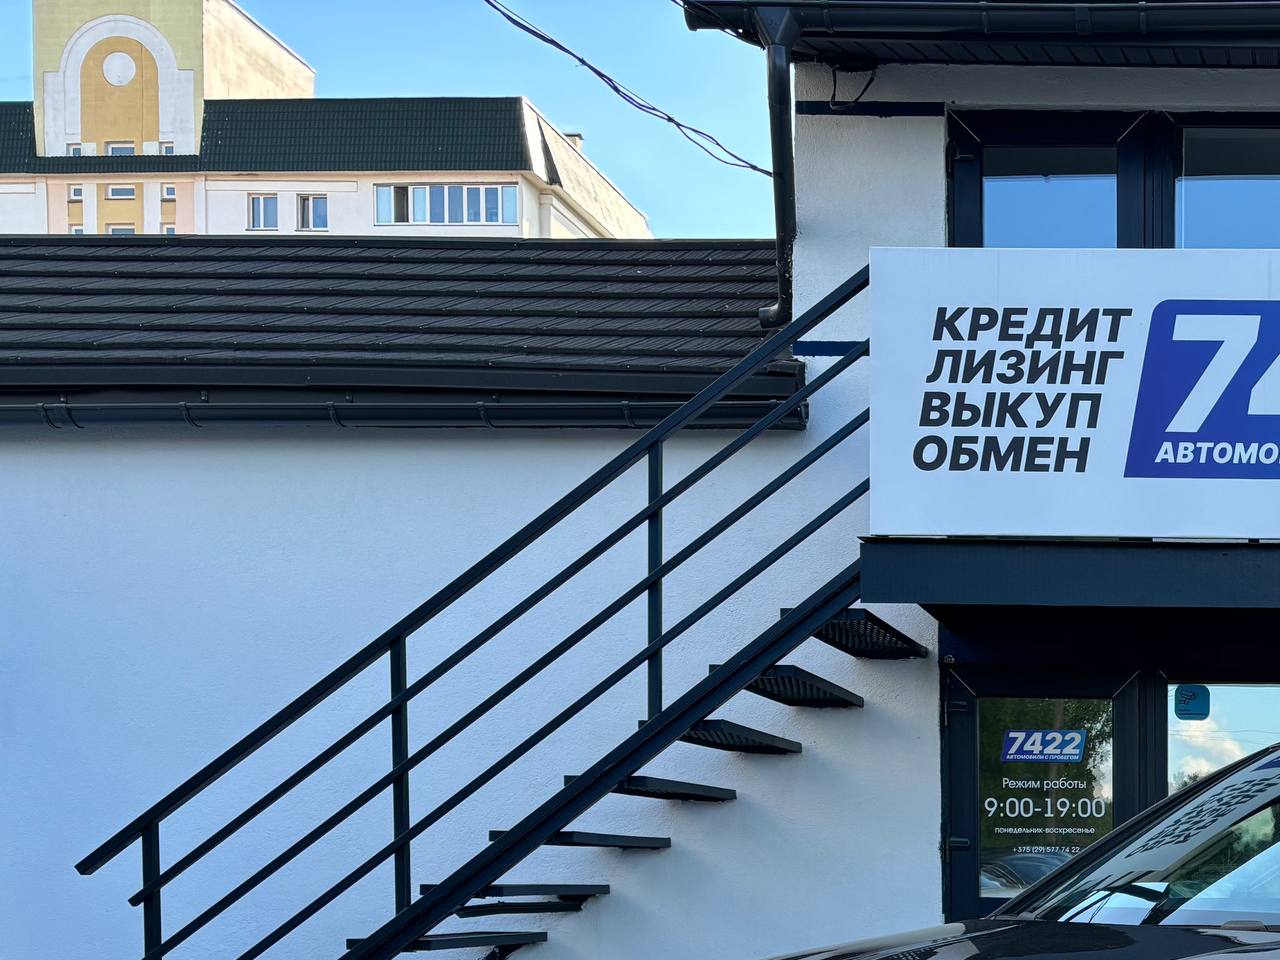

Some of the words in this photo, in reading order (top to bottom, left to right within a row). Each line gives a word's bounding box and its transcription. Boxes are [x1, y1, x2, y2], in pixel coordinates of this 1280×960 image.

[931, 307, 1133, 347] КРЕДИТ
[925, 349, 1126, 385] ЛИЗИНГ
[918, 392, 1103, 430] ВЫКУП
[912, 435, 1090, 474] ОБМЕН
[1008, 732, 1082, 754] 7422
[1002, 777, 1041, 789] Режим
[1043, 777, 1087, 791] работы
[984, 797, 1106, 818] 9:00-19:00
[994, 826, 1096, 835] понедельник-воскресенье
